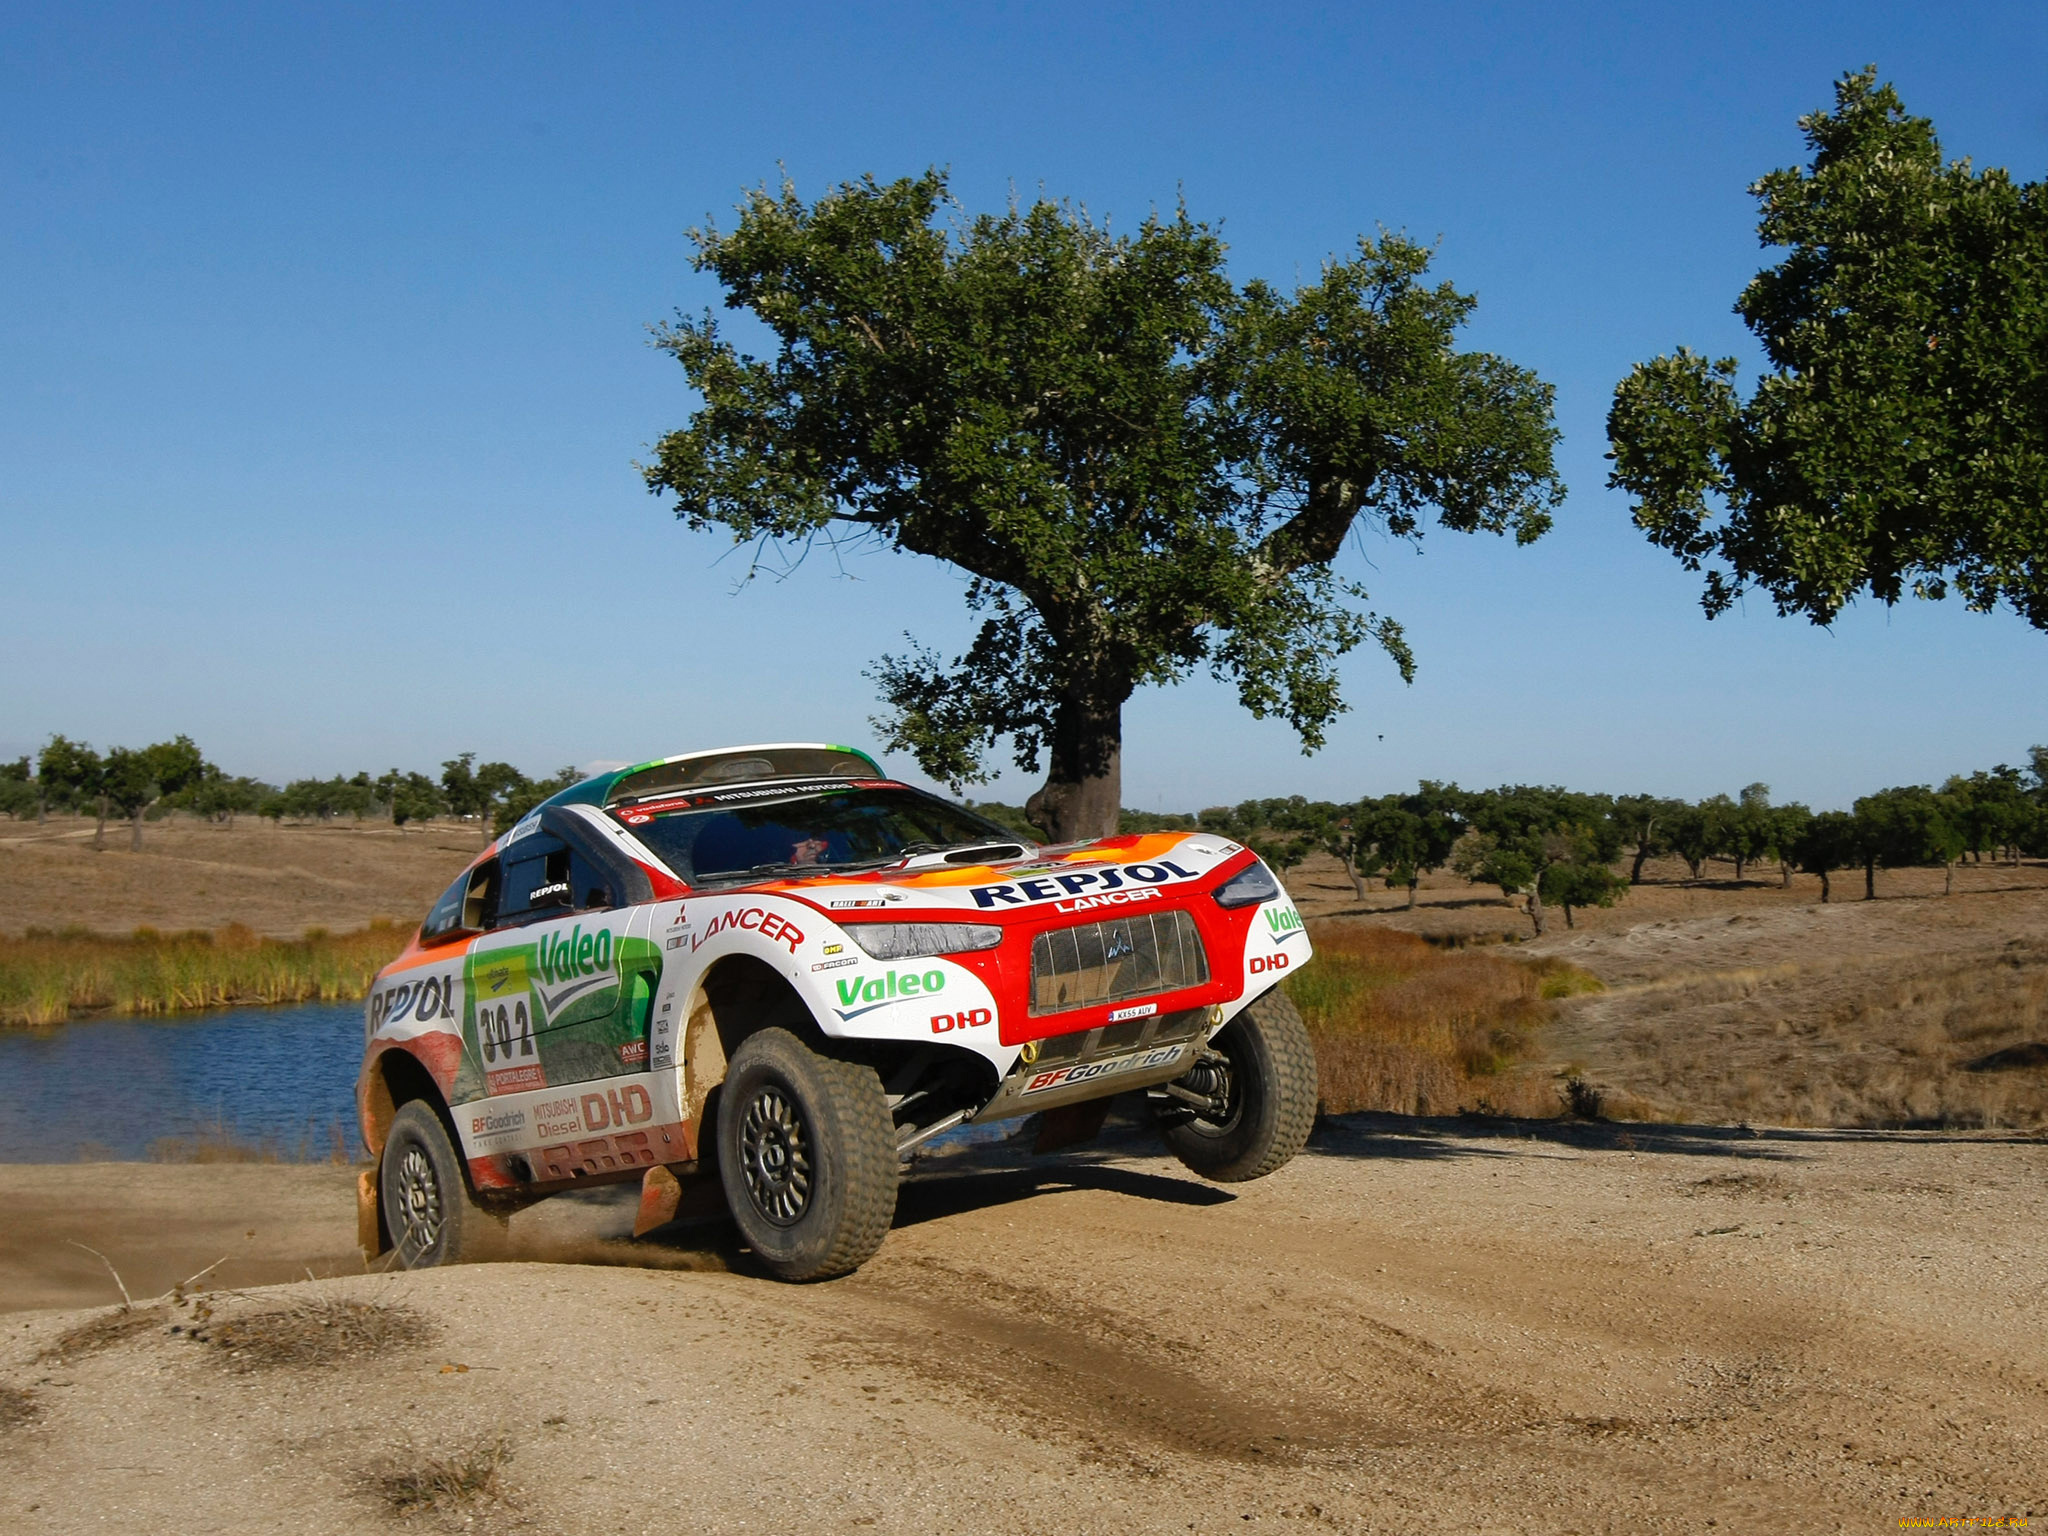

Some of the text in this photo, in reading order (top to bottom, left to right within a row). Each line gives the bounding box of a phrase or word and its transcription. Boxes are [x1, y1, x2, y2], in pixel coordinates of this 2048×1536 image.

[713, 782, 853, 802] MITSUBISHI MOTORS
[635, 800, 685, 814] vodafone
[529, 882, 568, 900] REPSOL
[969, 860, 1199, 908] REPSOL
[1054, 887, 1163, 913] LANCER
[691, 908, 805, 955] LANCER
[1263, 906, 1303, 932] Vale
[540, 923, 611, 986] Valeo
[836, 970, 945, 1006] Valeo
[370, 974, 455, 1036] REPSOL
[480, 1000, 533, 1064] 302
[622, 1042, 645, 1056] AWC
[1027, 1046, 1182, 1090] BFGoodrich
[472, 1110, 525, 1133] BFGoodrich
[533, 1097, 578, 1121] MITSUBISHI
[537, 1117, 582, 1138] Diesel
